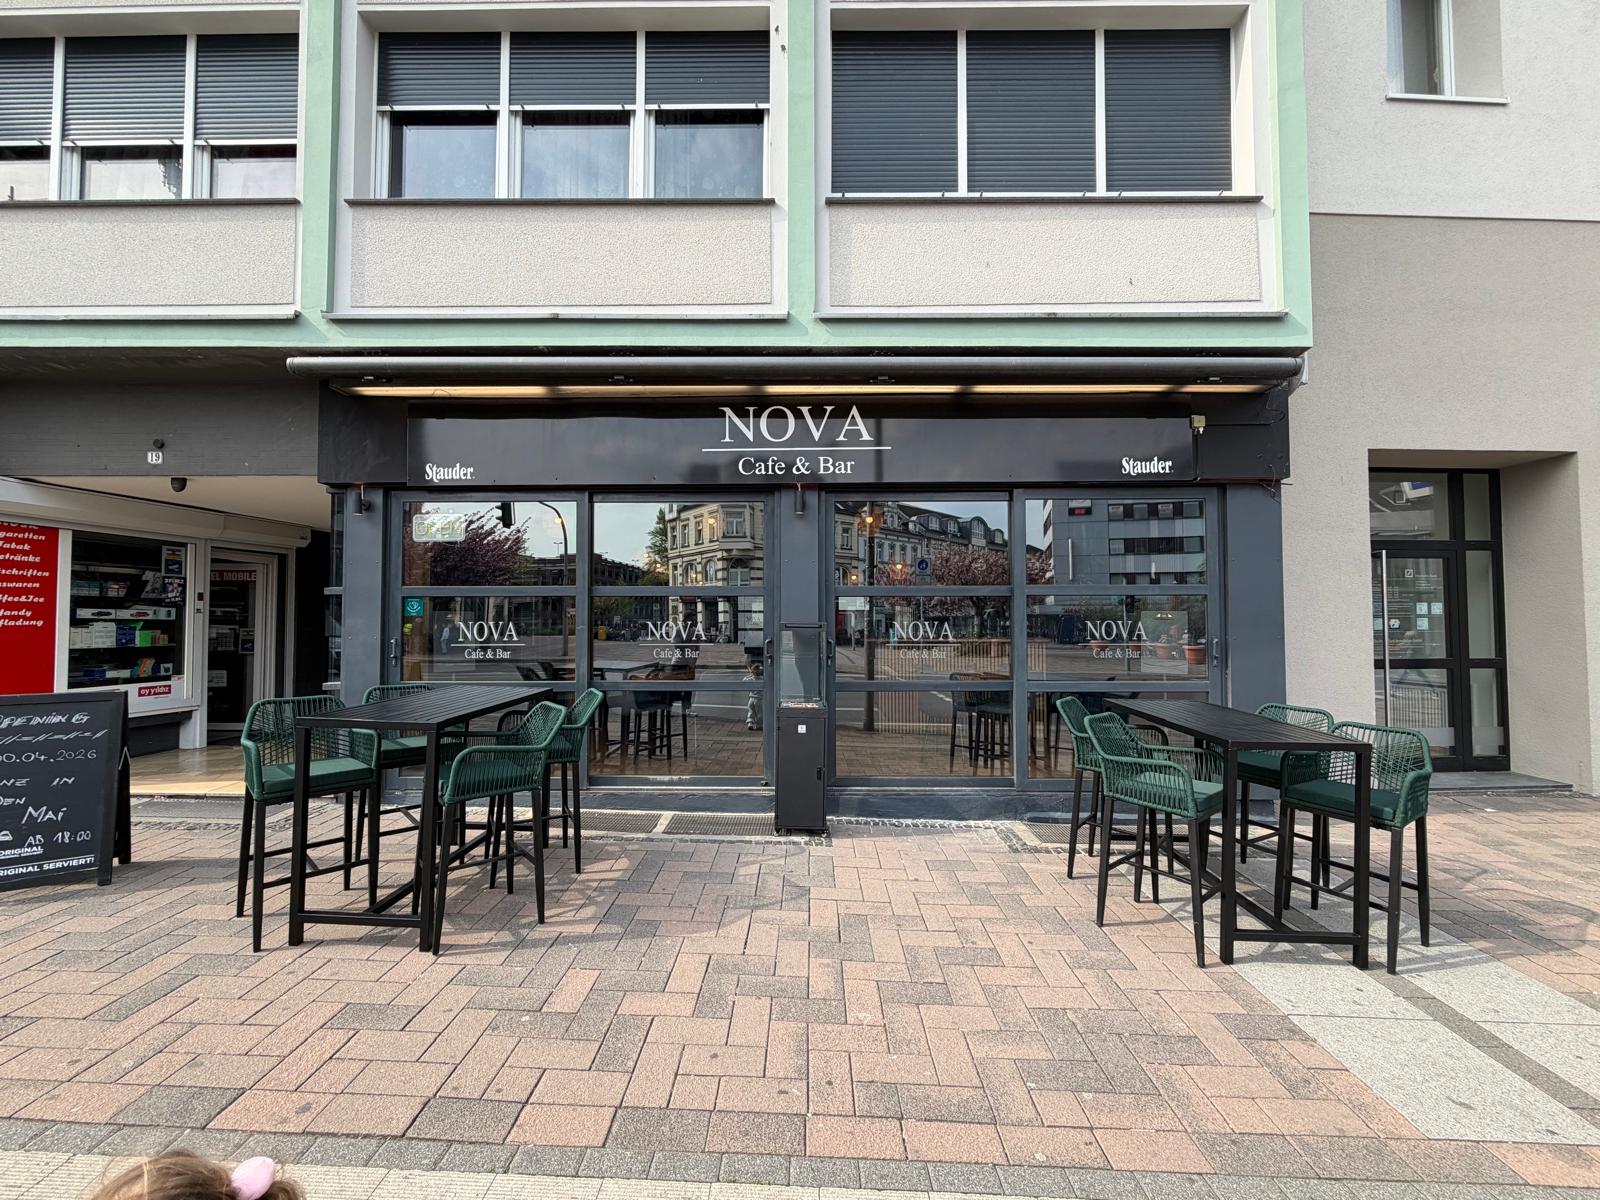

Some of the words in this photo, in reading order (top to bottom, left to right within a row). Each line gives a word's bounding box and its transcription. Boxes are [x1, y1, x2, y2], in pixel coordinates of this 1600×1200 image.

[718, 405, 874, 442] NOVA
[150, 452, 160, 462] 19
[425, 462, 474, 483] Stauder
[738, 456, 786, 475] Cafe
[792, 456, 811, 475] &
[818, 456, 855, 474] Bar
[1121, 456, 1173, 476] Stauder
[0, 567, 49, 577] schriften
[223, 571, 257, 581] MOBILE
[458, 621, 519, 641] NOVA
[647, 621, 707, 641] NOVA
[893, 621, 954, 641] NOVA
[1085, 620, 1148, 640] NOVA
[464, 648, 484, 658] Cafe
[485, 649, 494, 658] &
[496, 648, 511, 658] Bar
[653, 648, 673, 658] Cafe
[674, 648, 682, 658] &
[685, 648, 699, 658] Bar
[900, 648, 920, 659] Cafe
[921, 649, 929, 658] &
[932, 648, 947, 659] Bar
[1092, 648, 1113, 658] Cafe
[1114, 648, 1122, 658] &
[1125, 648, 1140, 658] Bar
[0, 749, 97, 763] 0.04.2026
[24, 834, 44, 848] AB
[53, 831, 91, 843] 18:00
[43, 857, 95, 870] SERVIERT!
